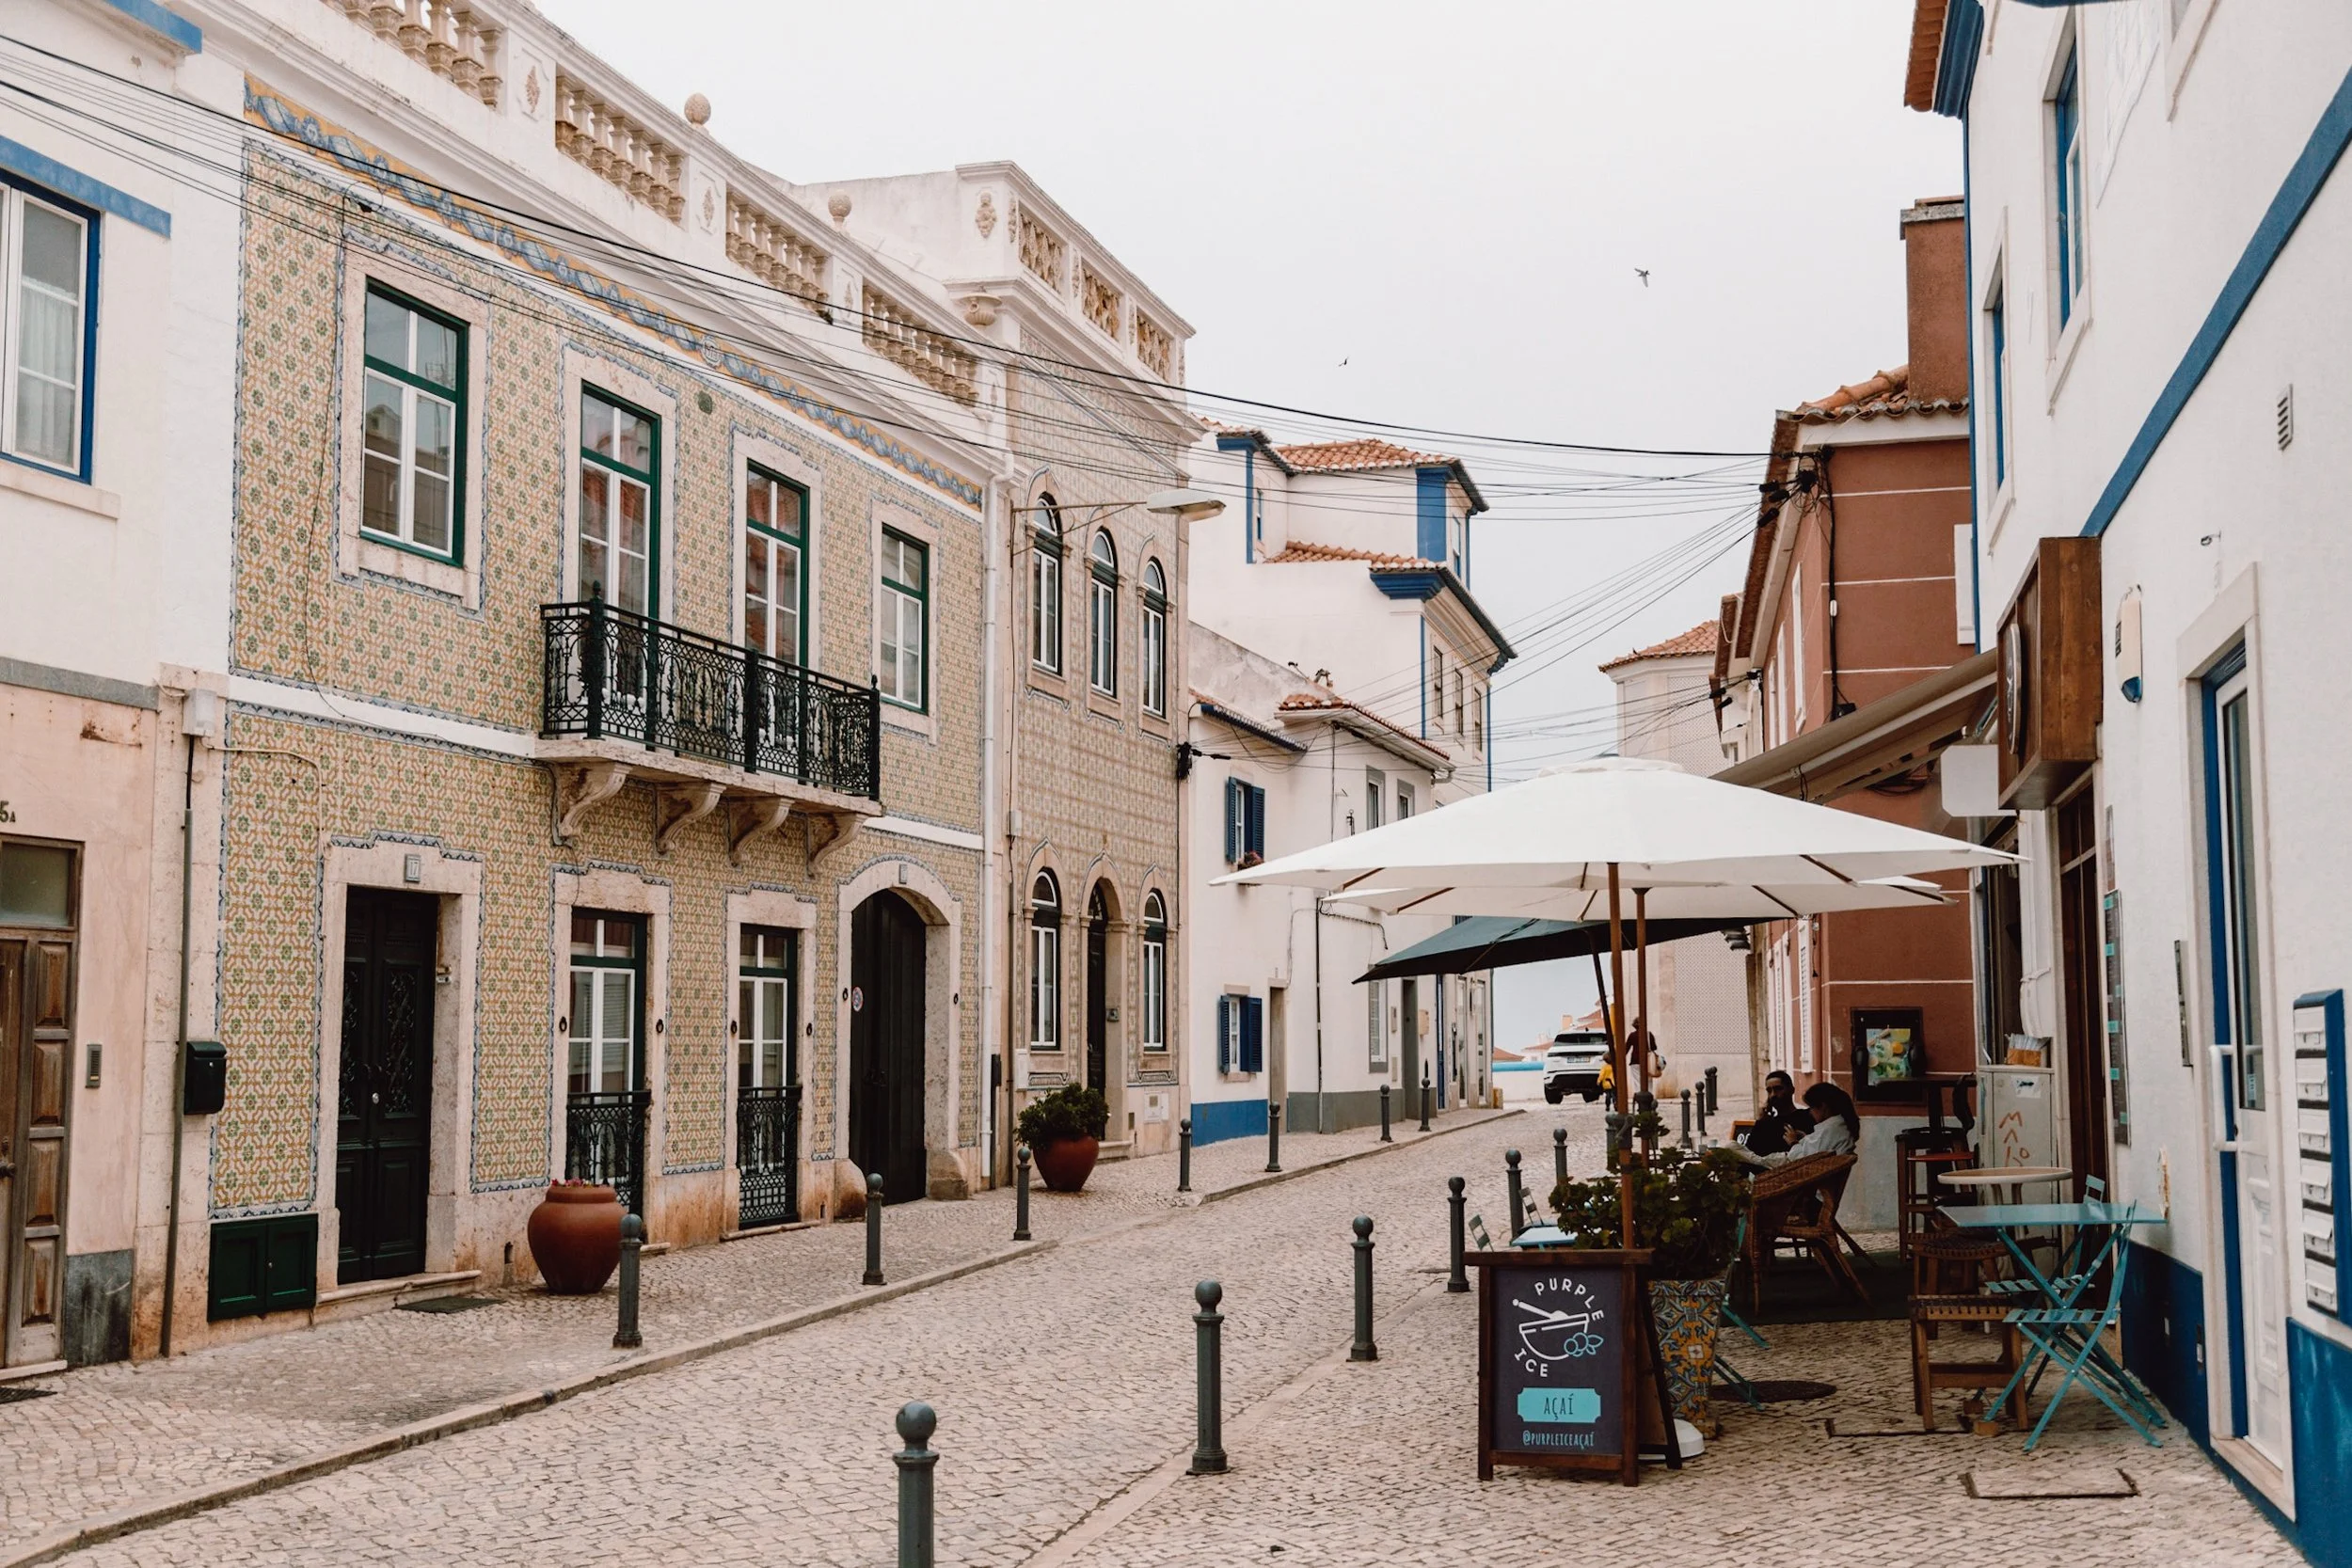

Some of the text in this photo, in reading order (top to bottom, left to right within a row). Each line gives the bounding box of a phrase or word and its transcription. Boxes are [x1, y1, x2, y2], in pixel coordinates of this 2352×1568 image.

[1534, 1278, 1604, 1321] PURPLE
[1515, 1348, 1549, 1377] ICE
[1544, 1393, 1574, 1420] AÇAÍ
